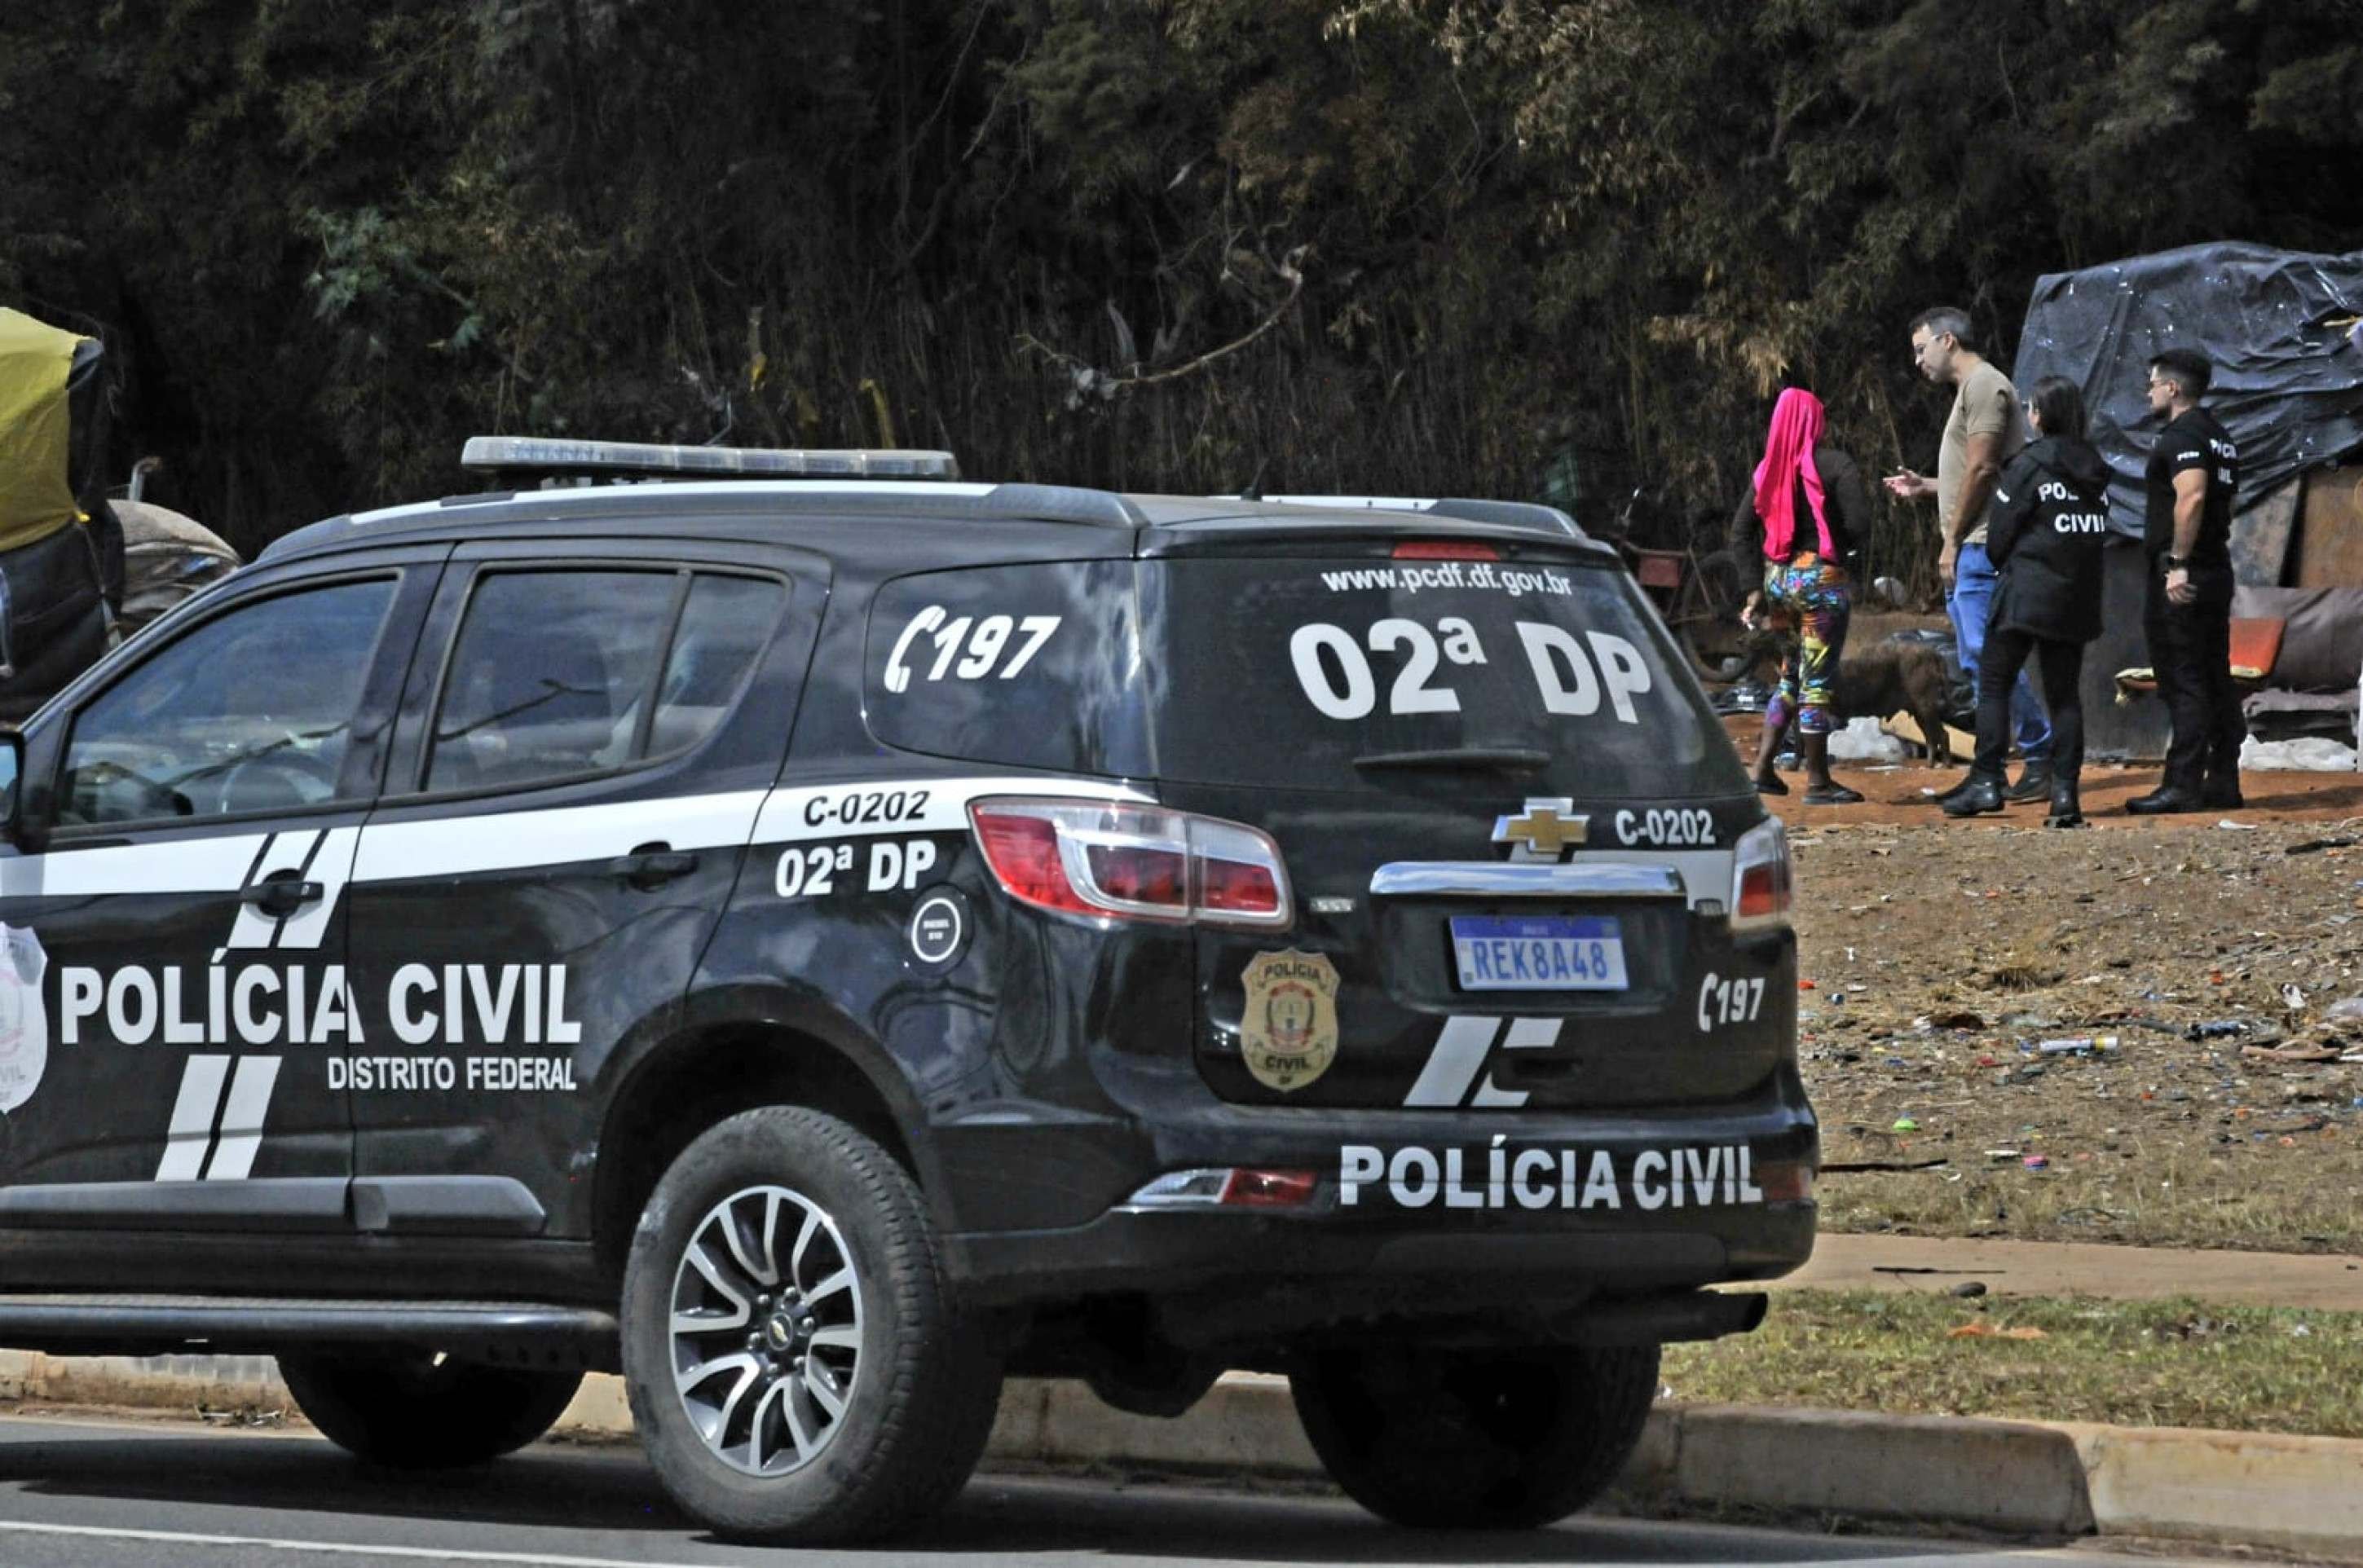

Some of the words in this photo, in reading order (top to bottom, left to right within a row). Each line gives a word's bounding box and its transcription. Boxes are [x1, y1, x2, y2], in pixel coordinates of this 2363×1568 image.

[1321, 563, 1572, 597] www.pcdf.df.gov.br
[928, 615, 1061, 680] 197
[1515, 621, 1651, 724] DP
[805, 791, 929, 826] C-0202
[1616, 809, 1715, 843] C-0202
[868, 840, 935, 892] DP
[1471, 940, 1607, 980] REK8A48
[61, 948, 364, 1045] POLÍCIA
[389, 963, 581, 1043] CIVIL
[1716, 977, 1764, 1023] 197
[328, 1057, 455, 1090] DISTRITO
[467, 1057, 576, 1090] FEDERAL
[1340, 1134, 1620, 1209] POLÍCIA
[1633, 1145, 1762, 1209] CIVIL
